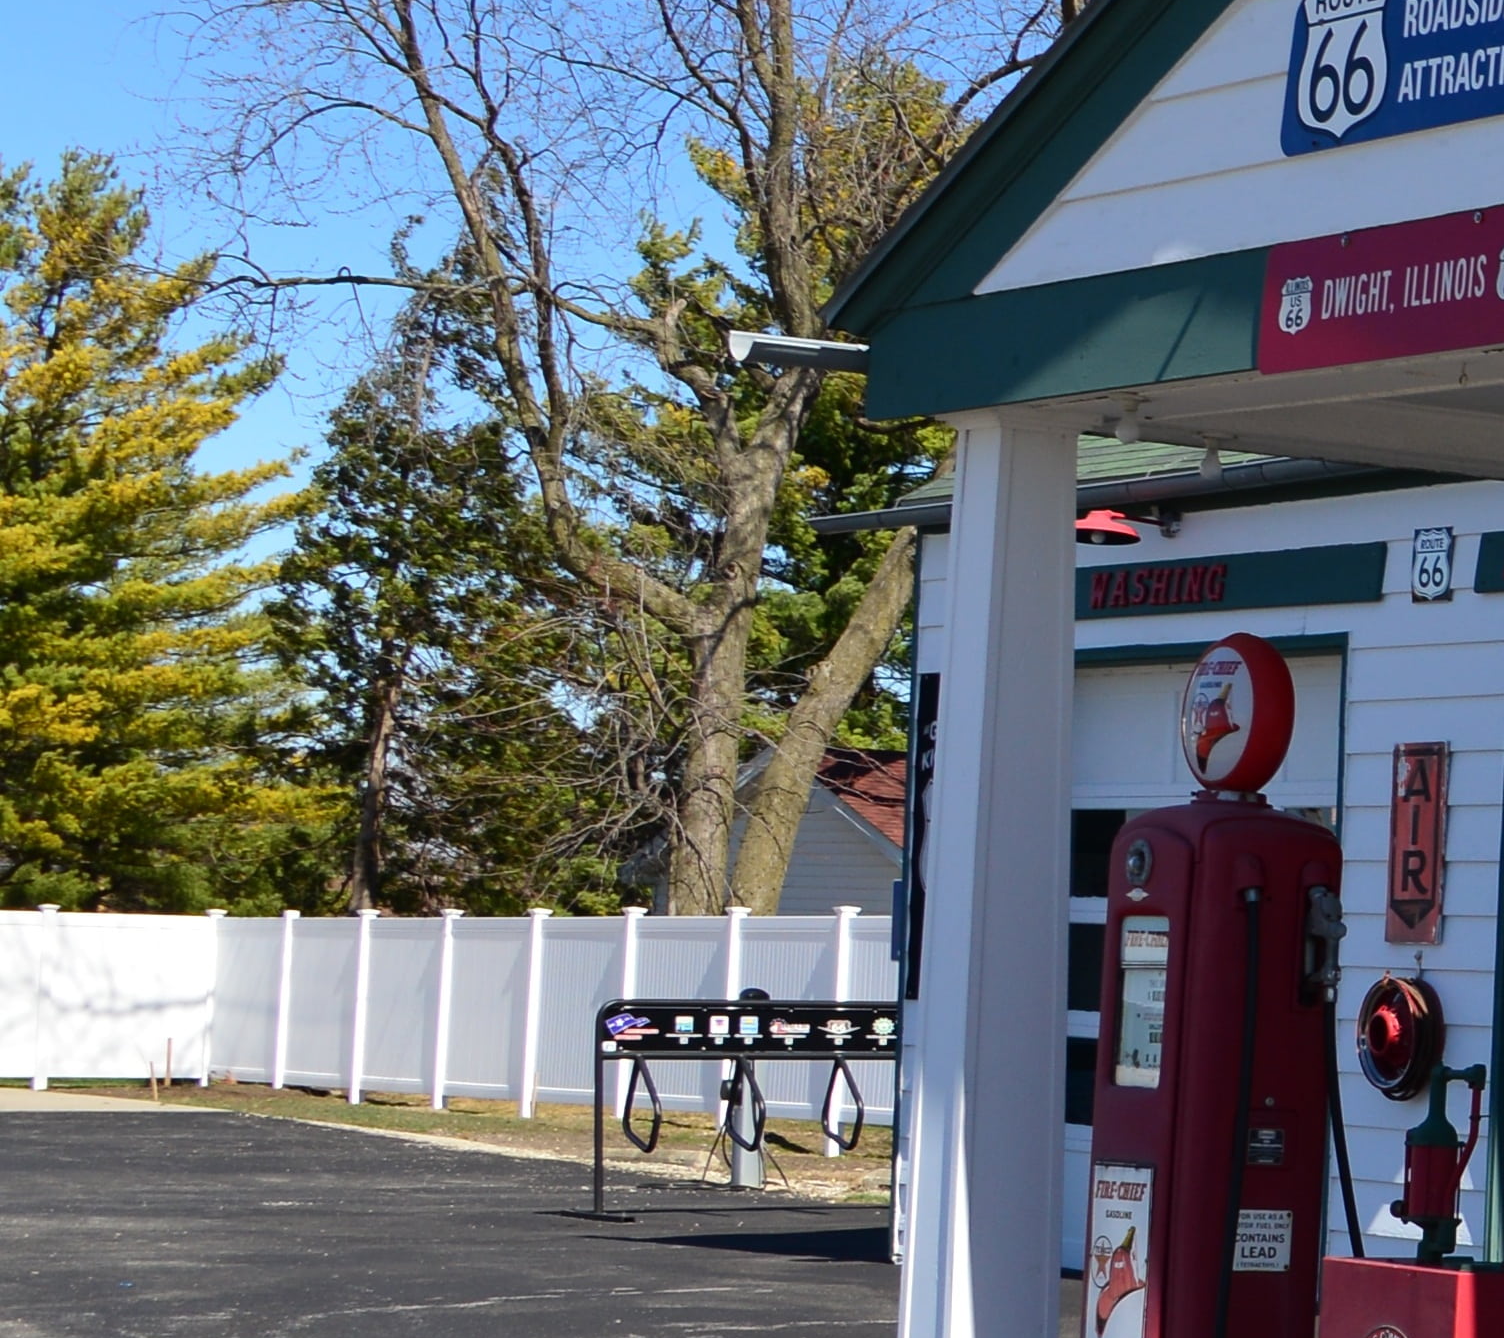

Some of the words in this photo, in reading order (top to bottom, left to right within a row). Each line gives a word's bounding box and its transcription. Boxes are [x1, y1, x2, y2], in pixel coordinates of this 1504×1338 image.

[1309, 18, 1376, 124] 66
[1284, 275, 1314, 294] ILLINOIS
[1321, 270, 1395, 320] DWIGHT,
[1403, 254, 1488, 308] ILLINOIS
[1289, 294, 1303, 308] US
[1284, 308, 1304, 330] 66
[1420, 537, 1444, 550] ROUTE
[1418, 555, 1444, 588] 66
[1089, 562, 1228, 610] WASHING
[1401, 757, 1433, 896] AIR
[1095, 1179, 1148, 1202] FIRE-CHIEF
[1105, 1209, 1133, 1220] GASOLINE
[1241, 1246, 1277, 1259] LEAD
